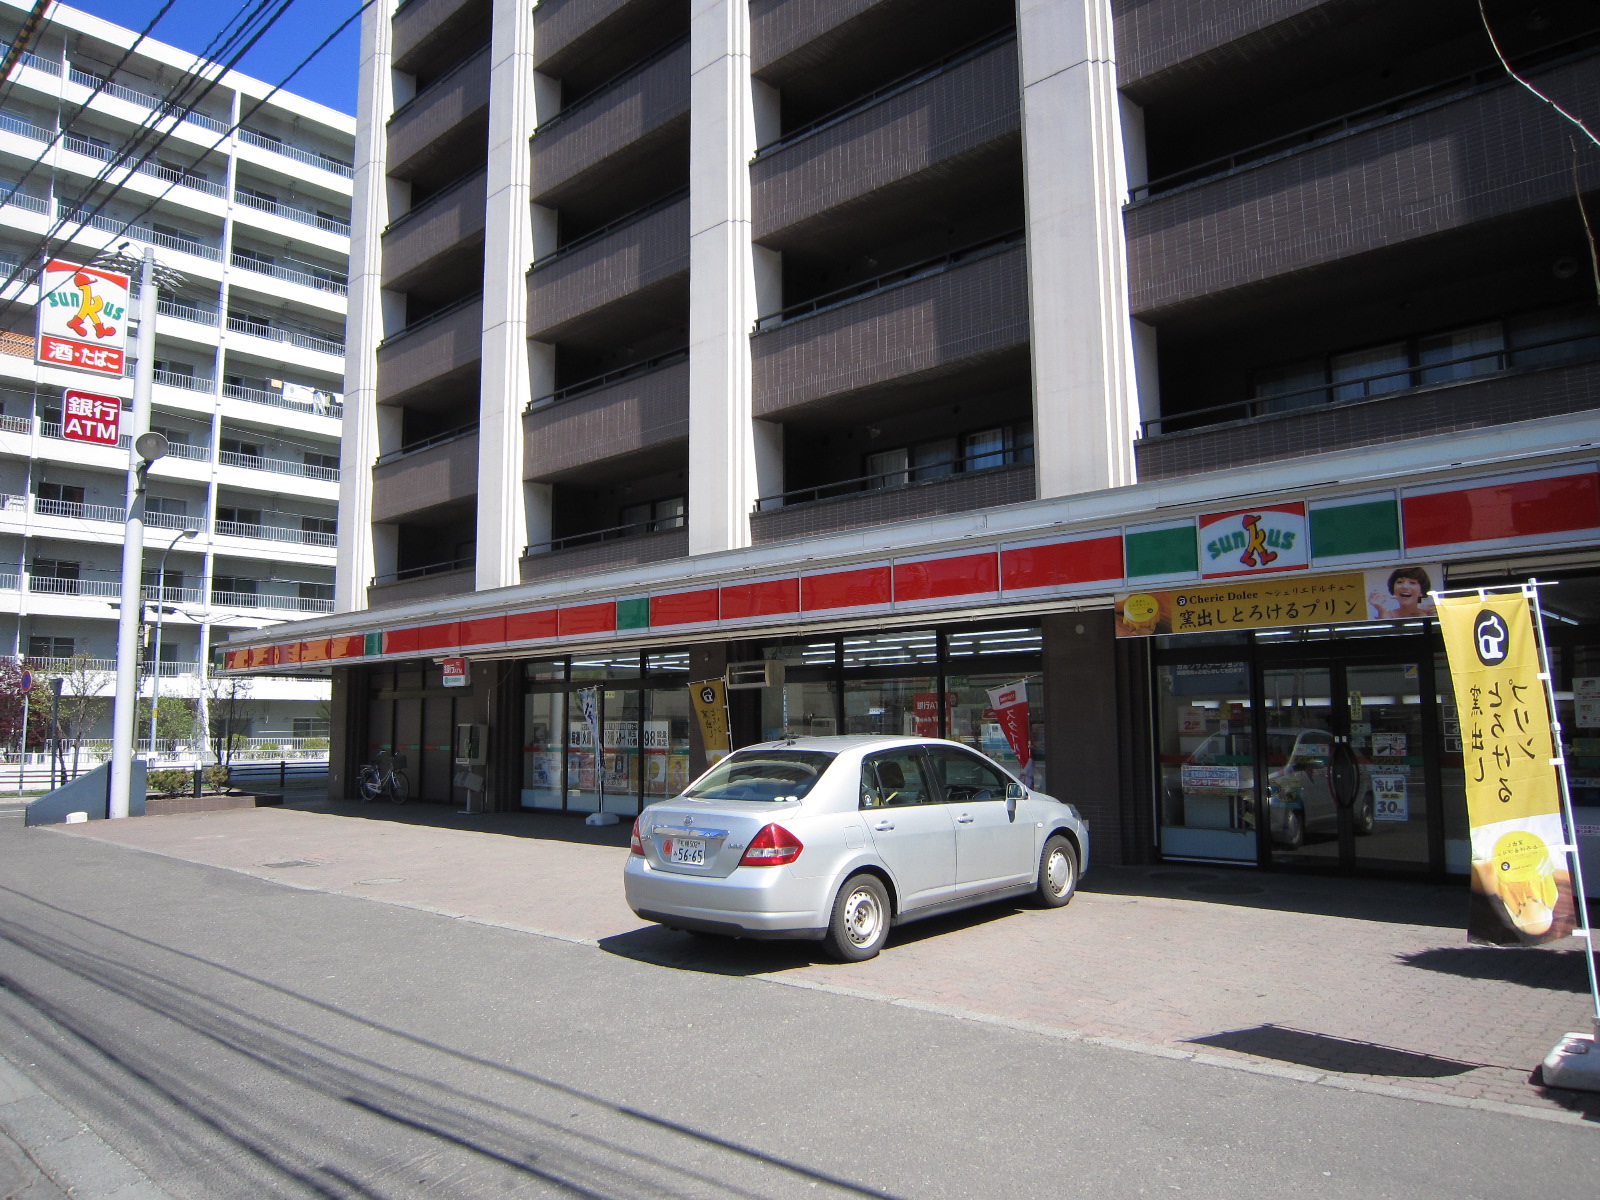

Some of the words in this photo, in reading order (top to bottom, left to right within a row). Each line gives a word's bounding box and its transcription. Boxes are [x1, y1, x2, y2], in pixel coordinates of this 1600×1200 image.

[48, 341, 120, 370] 酒・たばこ
[67, 396, 118, 421] 銀行
[65, 418, 116, 441] ATM
[1179, 598, 1358, 629] 窯出しとろけるプリン
[644, 731, 656, 746] 98
[678, 848, 703, 863] 56-65
